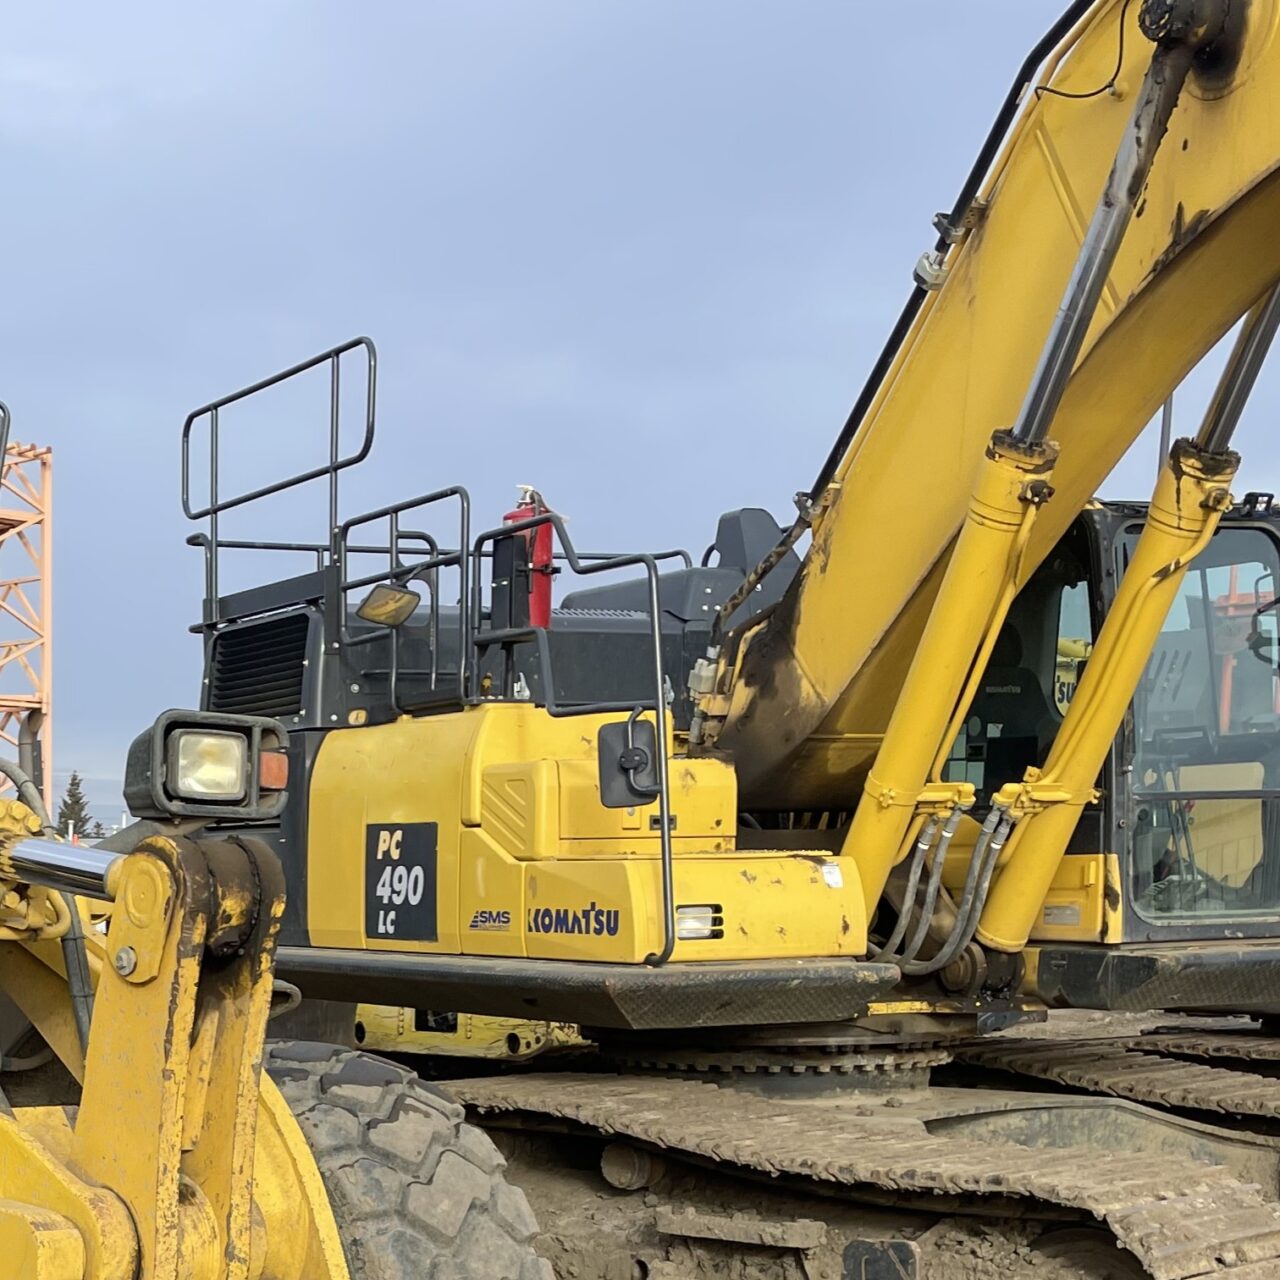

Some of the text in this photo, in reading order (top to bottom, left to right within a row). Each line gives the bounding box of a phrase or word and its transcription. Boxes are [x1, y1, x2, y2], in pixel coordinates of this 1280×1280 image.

[377, 829, 403, 860] PC
[376, 865, 425, 906] 490
[377, 910, 396, 934] LC
[479, 910, 511, 925] SMS
[527, 901, 620, 936] KOMATSU
